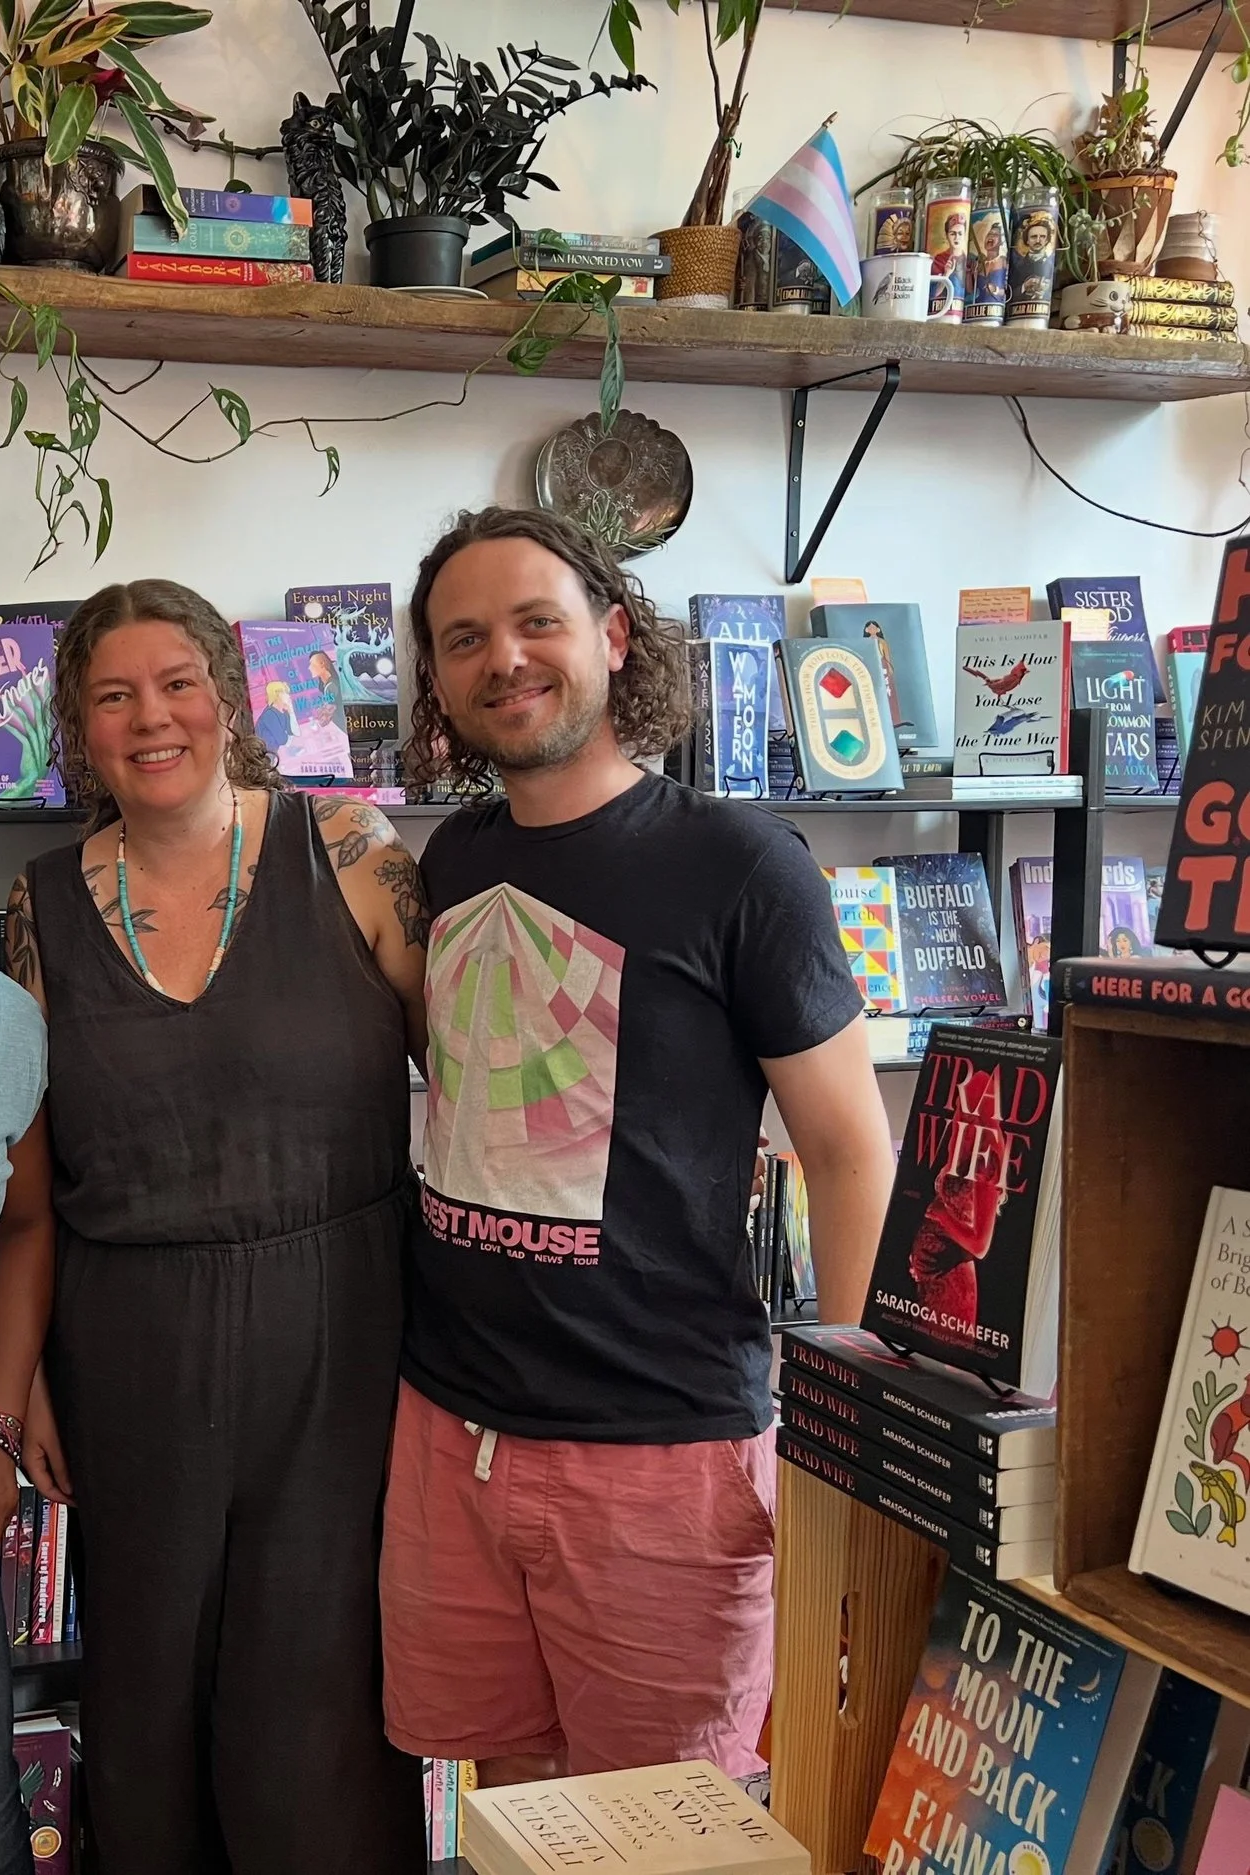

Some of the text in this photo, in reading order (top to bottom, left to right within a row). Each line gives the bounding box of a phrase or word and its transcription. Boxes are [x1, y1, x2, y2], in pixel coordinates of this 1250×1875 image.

[137, 261, 242, 277] CAZADORA
[551, 255, 565, 263] AN
[568, 254, 618, 266] HONORED
[620, 256, 644, 267] VOW
[293, 590, 388, 604] Eternal Night
[1074, 591, 1134, 607] SISTER
[363, 616, 389, 629] Sky
[718, 622, 770, 642] ALL
[248, 640, 323, 670] Entanglement
[962, 653, 1057, 669] This Is How
[974, 692, 1042, 709] You Lose
[1086, 676, 1146, 703] LIGHT
[345, 715, 395, 732] Bellows
[1202, 700, 1245, 728] KIM
[956, 734, 1059, 747] the Time War
[300, 766, 318, 774] SARA
[912, 763, 942, 772] TO EARTH
[1124, 765, 1150, 776] AOKI
[903, 884, 974, 909] BUFFALO
[928, 910, 960, 925] IS THE
[935, 928, 958, 943] NEW
[915, 945, 986, 972] BUFFALO
[914, 993, 1001, 1004] CHELSEA VOWEL
[1092, 976, 1217, 1006] HERE FOR A
[924, 1052, 1049, 1126] TRAD
[916, 1111, 1032, 1195] WIFE
[452, 1237, 599, 1265] WHO LOVE BAD NEWS TOUR
[469, 1211, 594, 1273] MOUSE
[1210, 1275, 1233, 1291] of
[875, 1290, 937, 1324] SARATOGA
[940, 1314, 1010, 1350] SCHAEFER
[791, 1343, 952, 1432] TRAD WIFE SARATOGA SCHAEFER
[40, 1542, 49, 1564] Court
[38, 1566, 48, 1574] of
[38, 1576, 48, 1623] Wanderers
[959, 1599, 1002, 1663] TO
[1007, 1627, 1073, 1708] THE
[950, 1662, 1044, 1761] MOON
[907, 1704, 1058, 1843] AND BACK
[611, 1799, 658, 1839] FORTY
[654, 1789, 715, 1836] ENDS
[685, 1771, 774, 1844] TELL ME
[509, 1798, 586, 1866] LUISELLI
[537, 1794, 605, 1863] VALERIA
[586, 1794, 646, 1850] QUESTIONS
